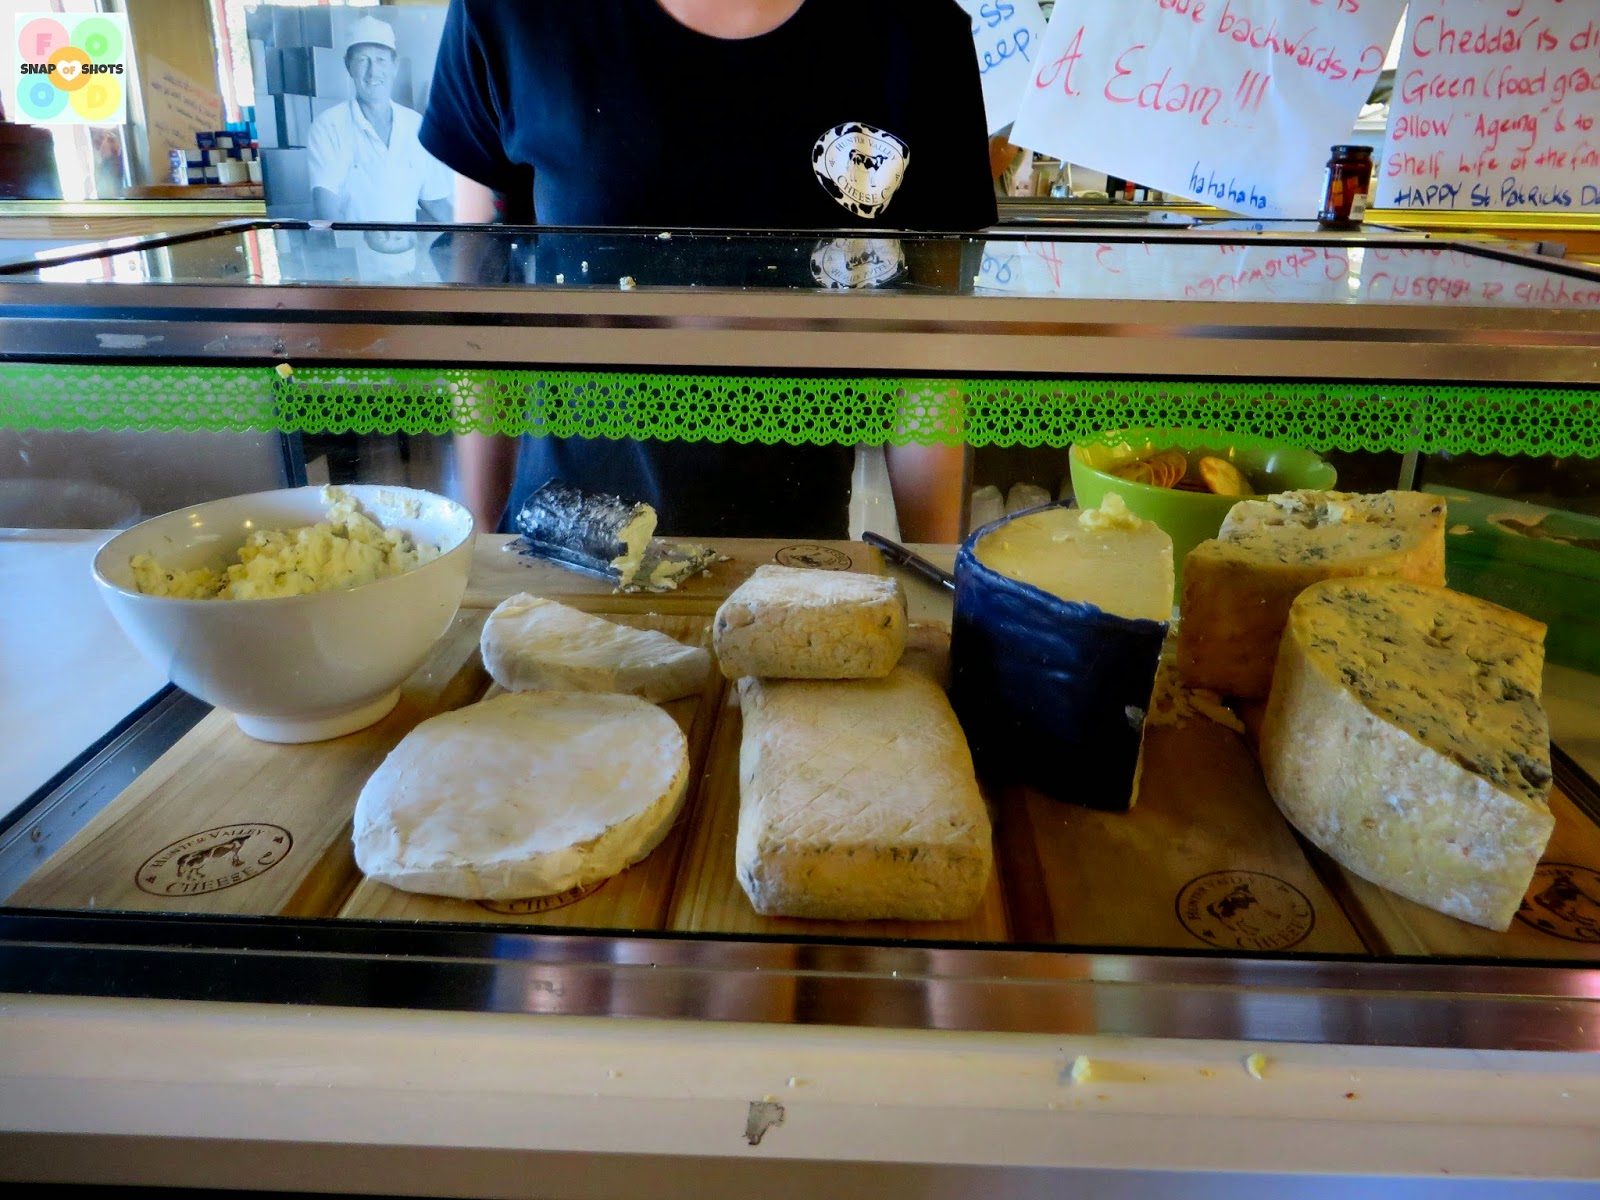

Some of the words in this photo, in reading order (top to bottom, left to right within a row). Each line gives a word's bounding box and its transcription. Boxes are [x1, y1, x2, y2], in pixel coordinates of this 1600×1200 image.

[1412, 15, 1540, 58] Cheddar
[1537, 27, 1559, 51] is
[1402, 69, 1476, 104] Green
[1392, 112, 1454, 140] allow
[1573, 113, 1594, 131] to
[1393, 182, 1463, 208] HAPPY
[151, 838, 205, 868] HUNTER
[208, 829, 266, 839] VALLEY
[165, 867, 258, 893] CHEESE
